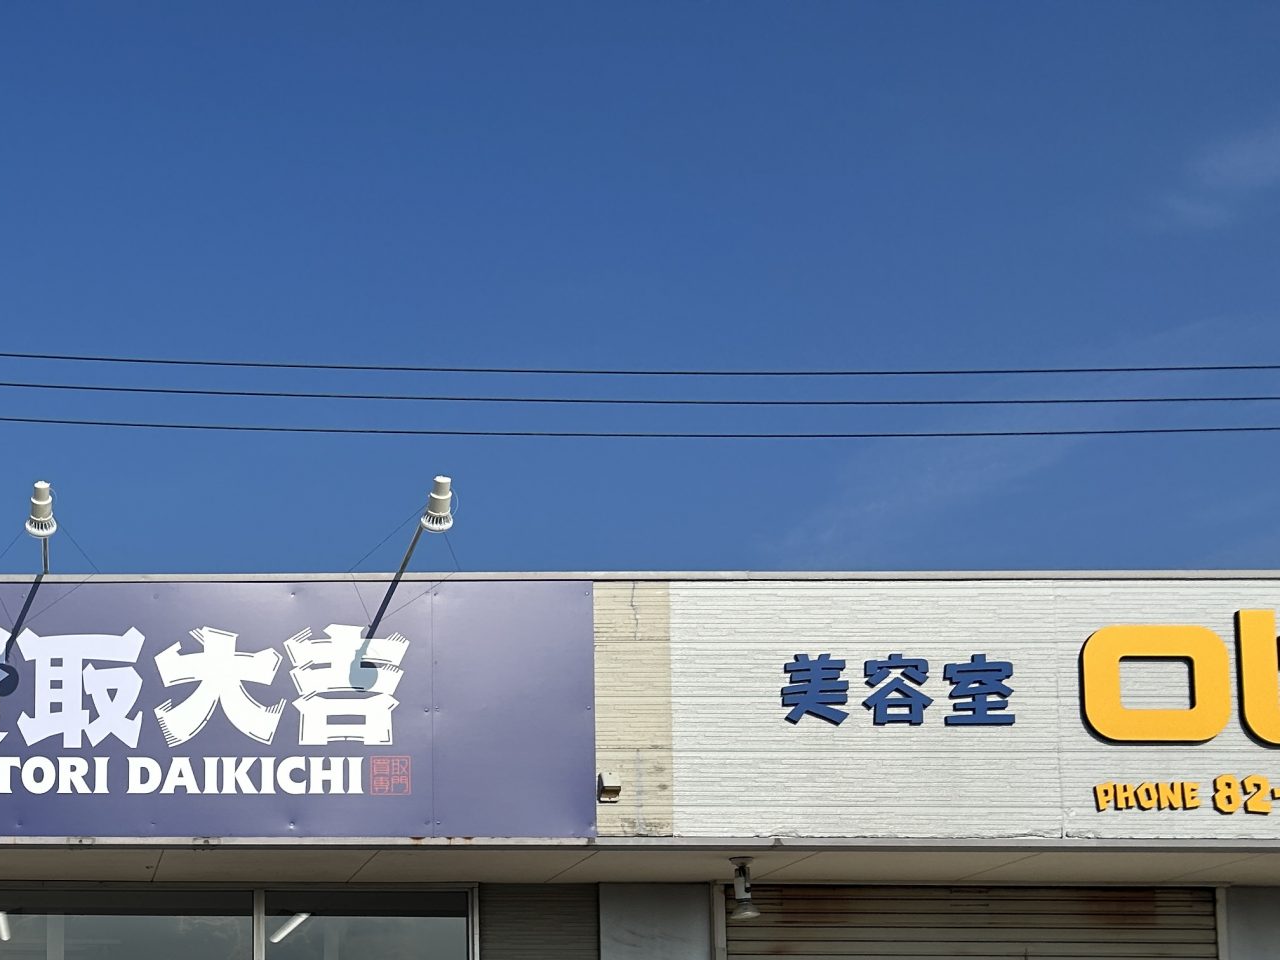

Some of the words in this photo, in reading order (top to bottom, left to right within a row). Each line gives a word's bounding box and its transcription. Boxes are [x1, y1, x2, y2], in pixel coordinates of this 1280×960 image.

[781, 654, 1015, 726] 美容室
[127, 756, 365, 794] DAIKICHI
[1095, 782, 1200, 811] PHONE
